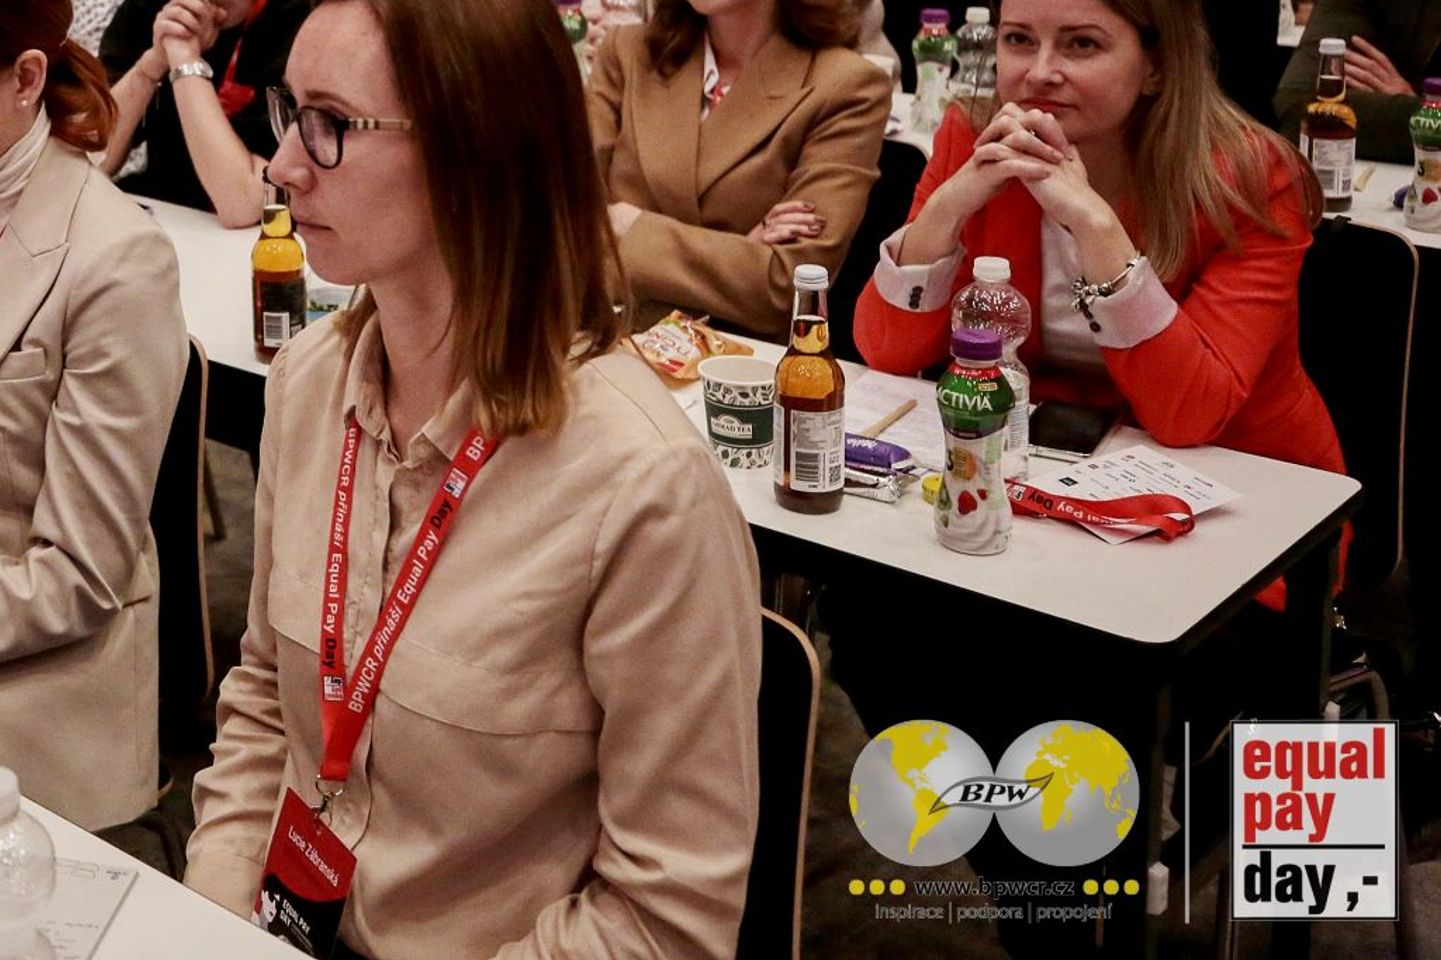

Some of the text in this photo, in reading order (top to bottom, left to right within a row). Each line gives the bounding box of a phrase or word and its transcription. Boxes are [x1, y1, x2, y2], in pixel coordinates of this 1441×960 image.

[1028, 489, 1054, 511] Day
[1056, 500, 1085, 520] Pay
[328, 553, 342, 598] Equal
[323, 602, 338, 634] Pay
[348, 656, 378, 714] BPWCR
[396, 558, 425, 604] Equal
[416, 529, 440, 561] Pay
[429, 497, 454, 530] Day
[322, 637, 337, 669] Day
